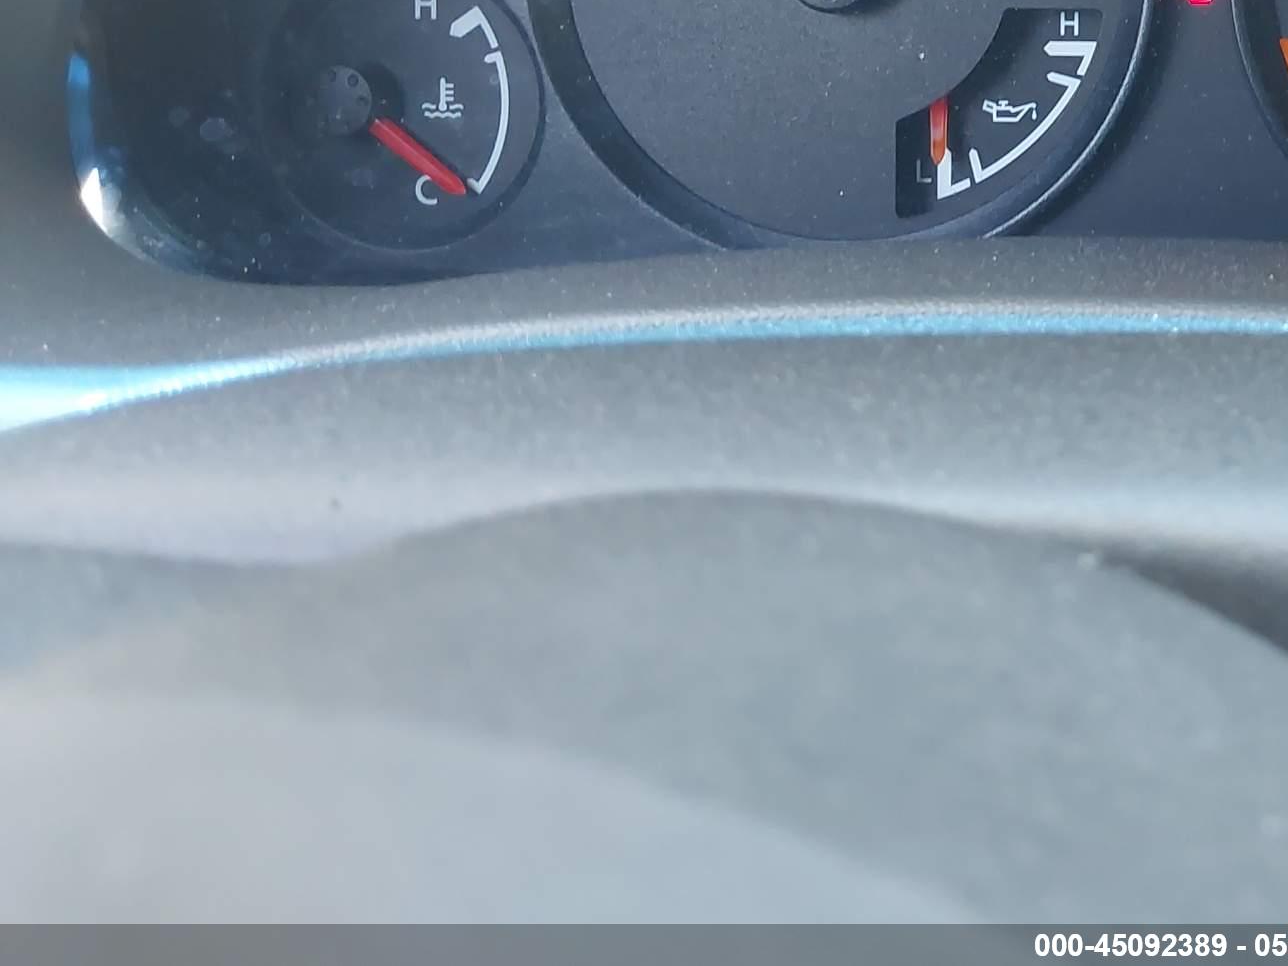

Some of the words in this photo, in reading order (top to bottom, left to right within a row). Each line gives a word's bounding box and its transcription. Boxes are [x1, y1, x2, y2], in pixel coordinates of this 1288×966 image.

[1059, 11, 1079, 36] H
[916, 159, 932, 183] L
[415, 175, 438, 206] C
